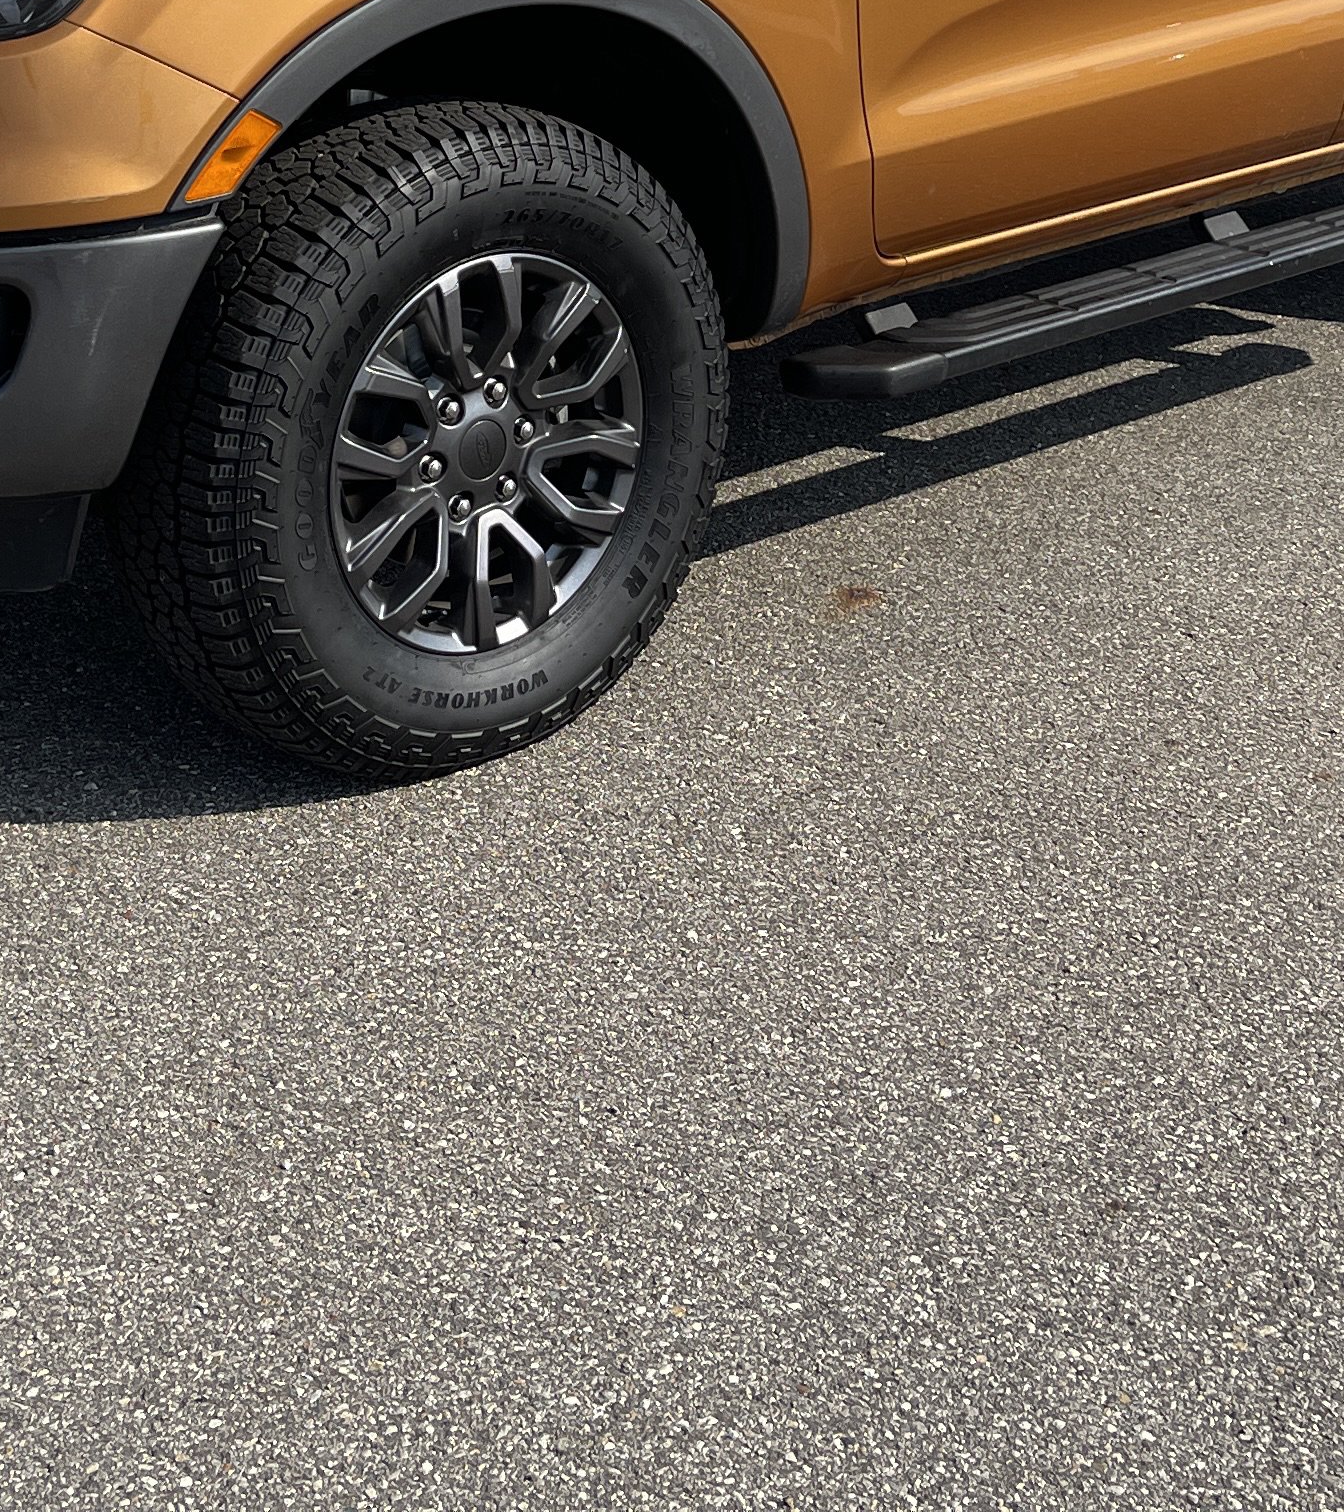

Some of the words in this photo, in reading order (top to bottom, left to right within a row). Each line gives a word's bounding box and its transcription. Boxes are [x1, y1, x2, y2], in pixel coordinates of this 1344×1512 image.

[294, 293, 381, 571] GOODYEAR
[621, 364, 695, 600] WRANGLER
[407, 669, 549, 710] WORKHORSE
